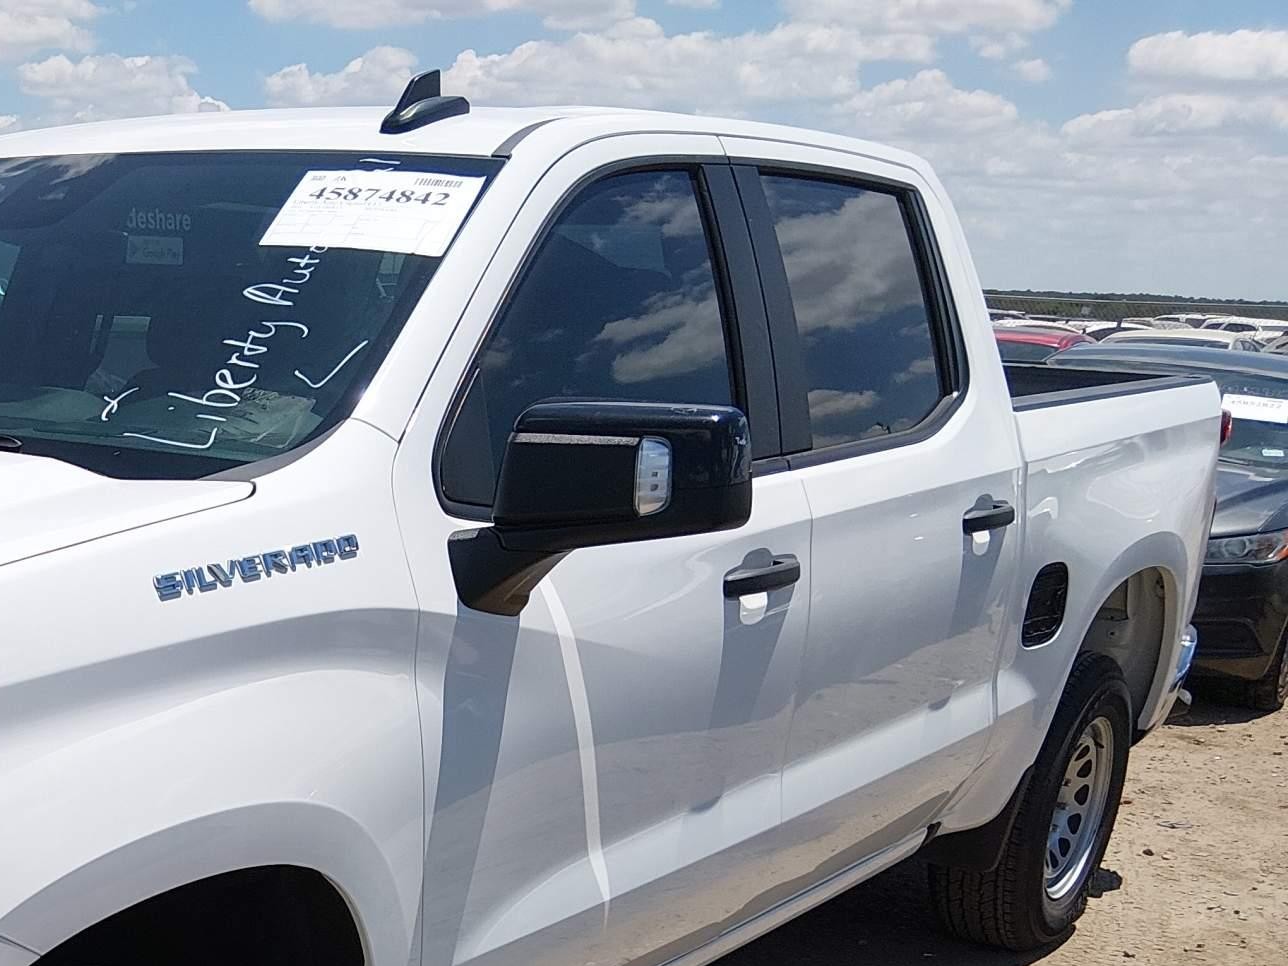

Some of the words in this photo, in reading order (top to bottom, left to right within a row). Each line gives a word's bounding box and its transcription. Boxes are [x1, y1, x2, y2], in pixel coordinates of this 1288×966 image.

[309, 187, 451, 206] 45874842
[123, 321, 309, 448] Liberty
[153, 533, 360, 602] SILVERADO
